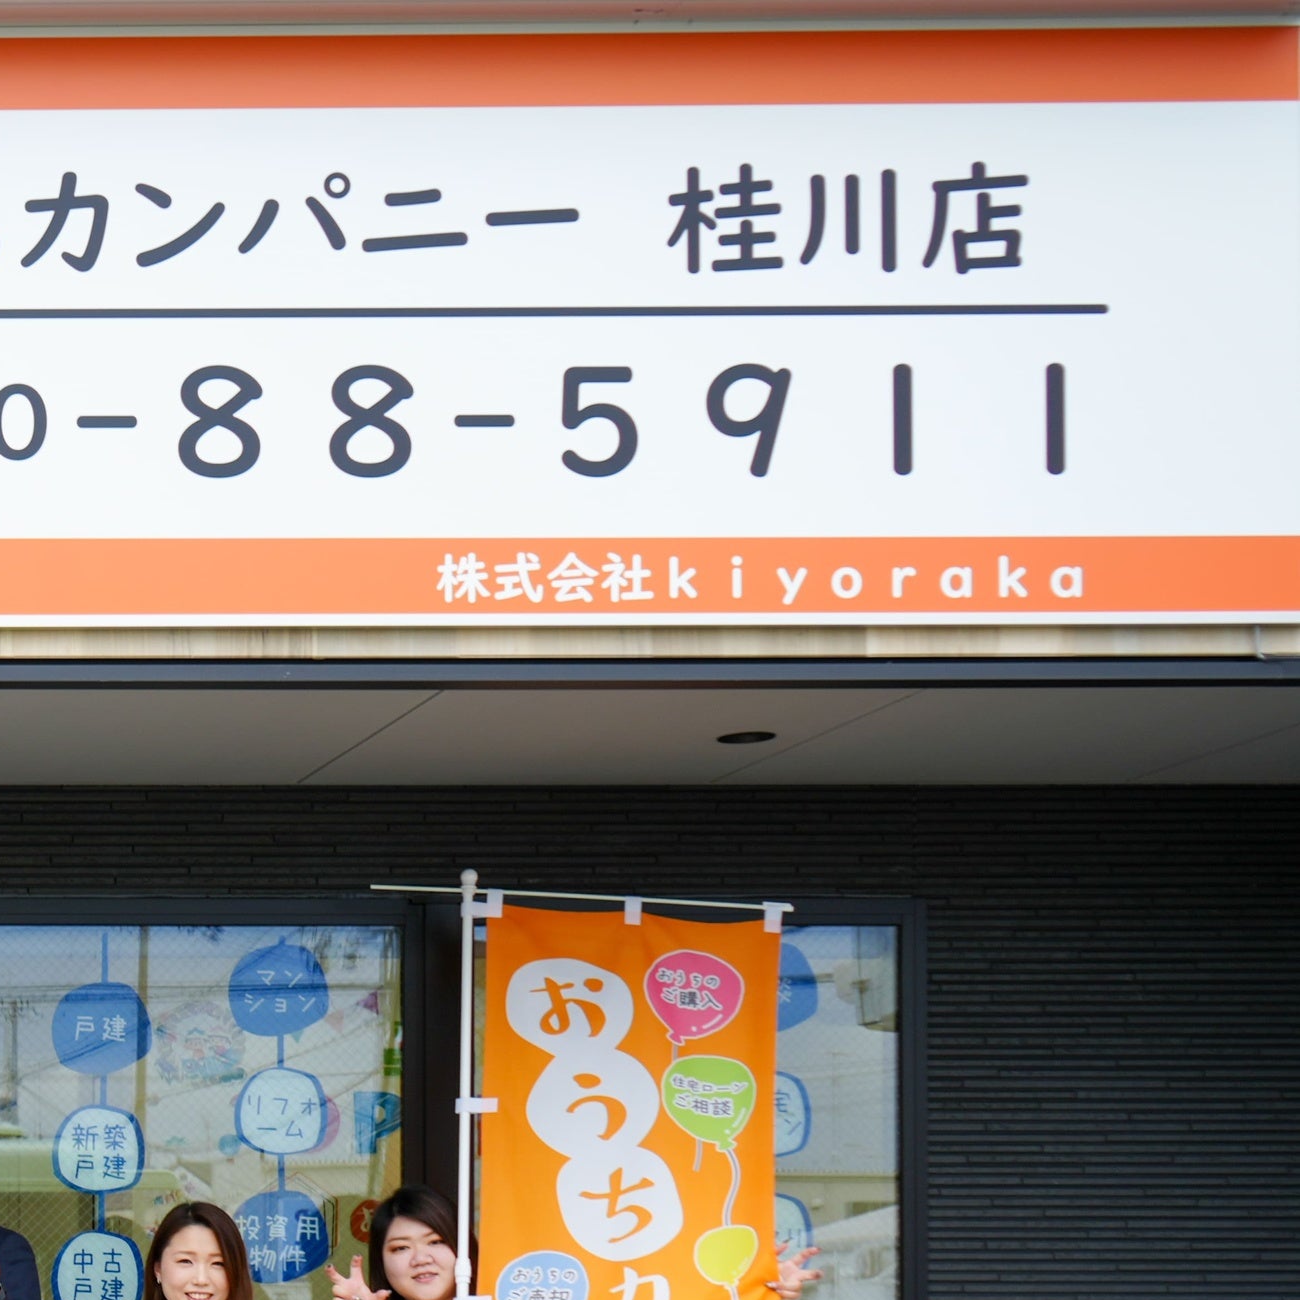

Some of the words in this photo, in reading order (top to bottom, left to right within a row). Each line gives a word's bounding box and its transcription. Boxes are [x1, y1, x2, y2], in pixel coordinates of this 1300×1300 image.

[667, 162, 1029, 274] 桂川店
[656, 968, 720, 989] おうちの
[661, 986, 723, 1011] ご購入
[74, 1013, 128, 1044] 戸建
[671, 1074, 748, 1095] 住宅ローン
[674, 1093, 734, 1117] ご相談
[71, 1123, 128, 1150] 新築
[74, 1155, 128, 1180] 戸建
[236, 1215, 320, 1243] 投資用
[73, 1248, 122, 1273] 中古
[249, 1244, 307, 1272] 物件
[511, 1266, 578, 1284] おうちの
